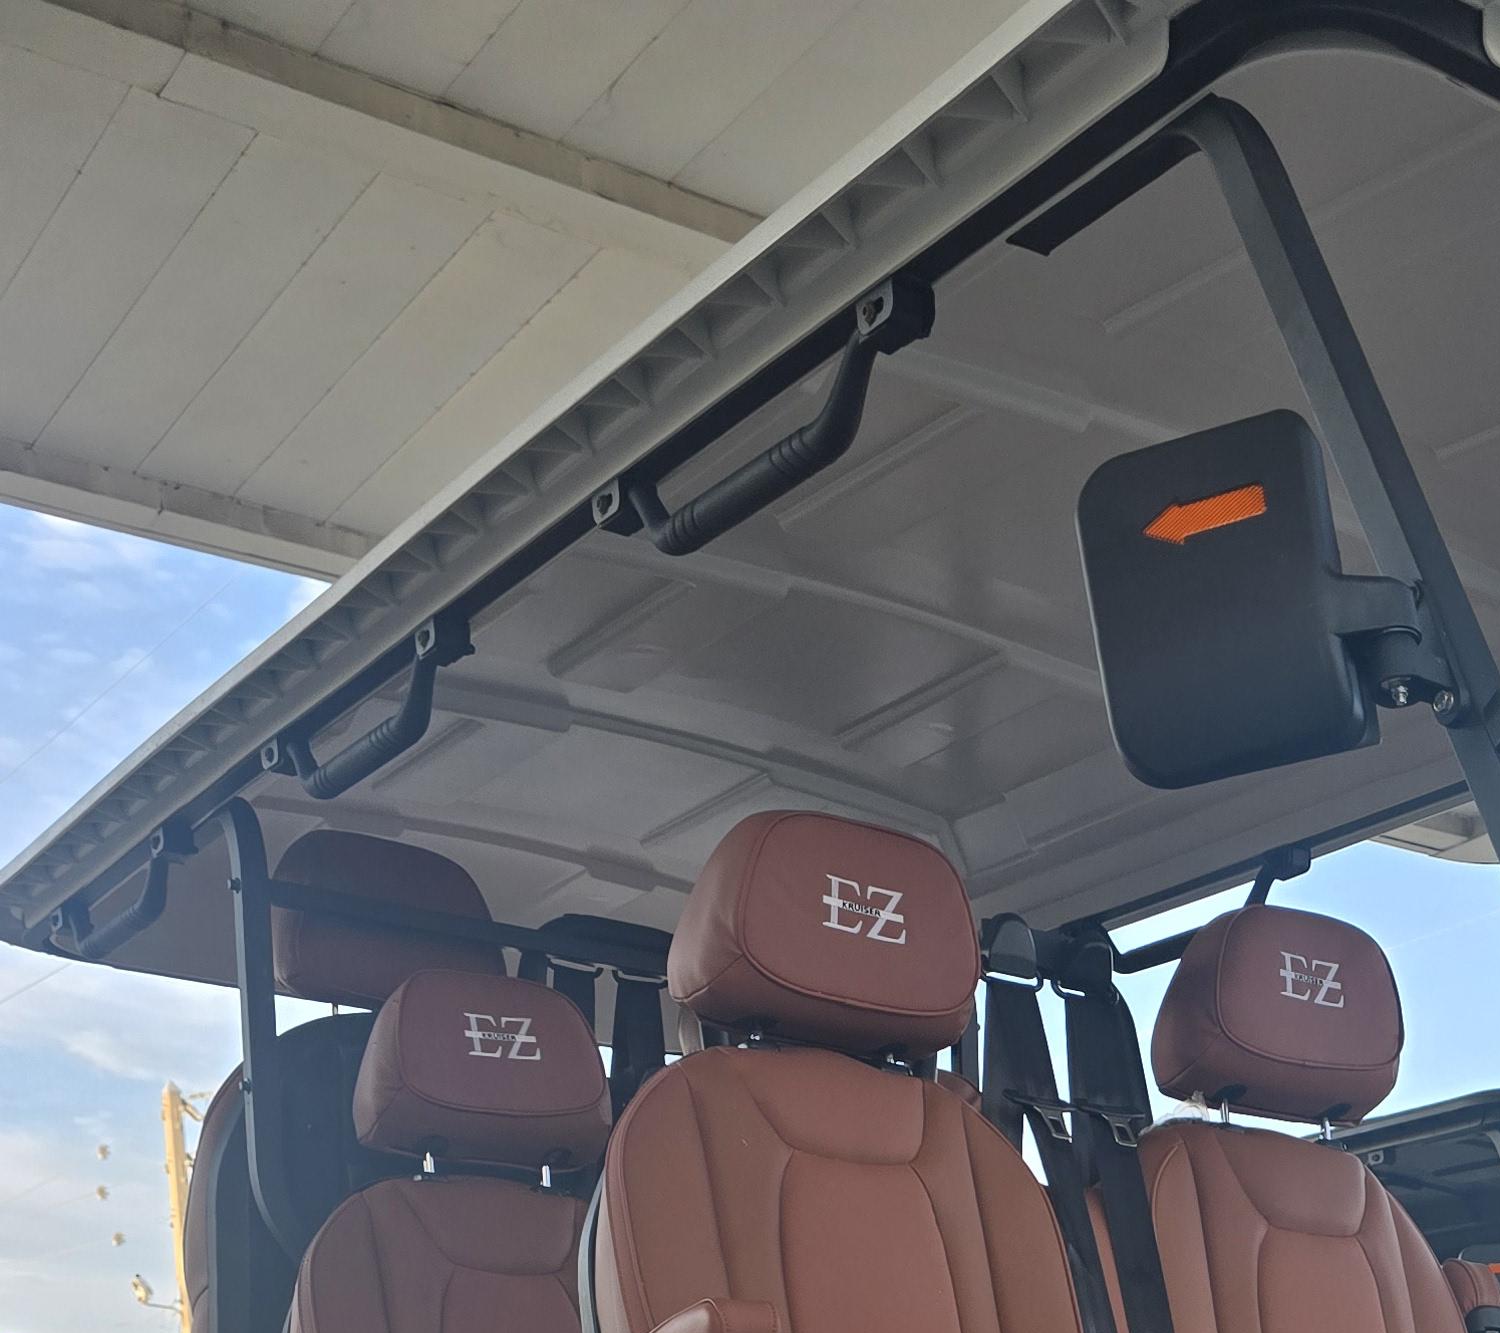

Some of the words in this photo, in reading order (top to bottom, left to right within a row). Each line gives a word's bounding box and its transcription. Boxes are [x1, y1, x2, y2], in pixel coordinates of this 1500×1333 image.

[822, 873, 906, 945] EZ
[841, 899, 883, 918] KRUISER
[1280, 951, 1345, 1008] EZ
[463, 1012, 542, 1060] EZ
